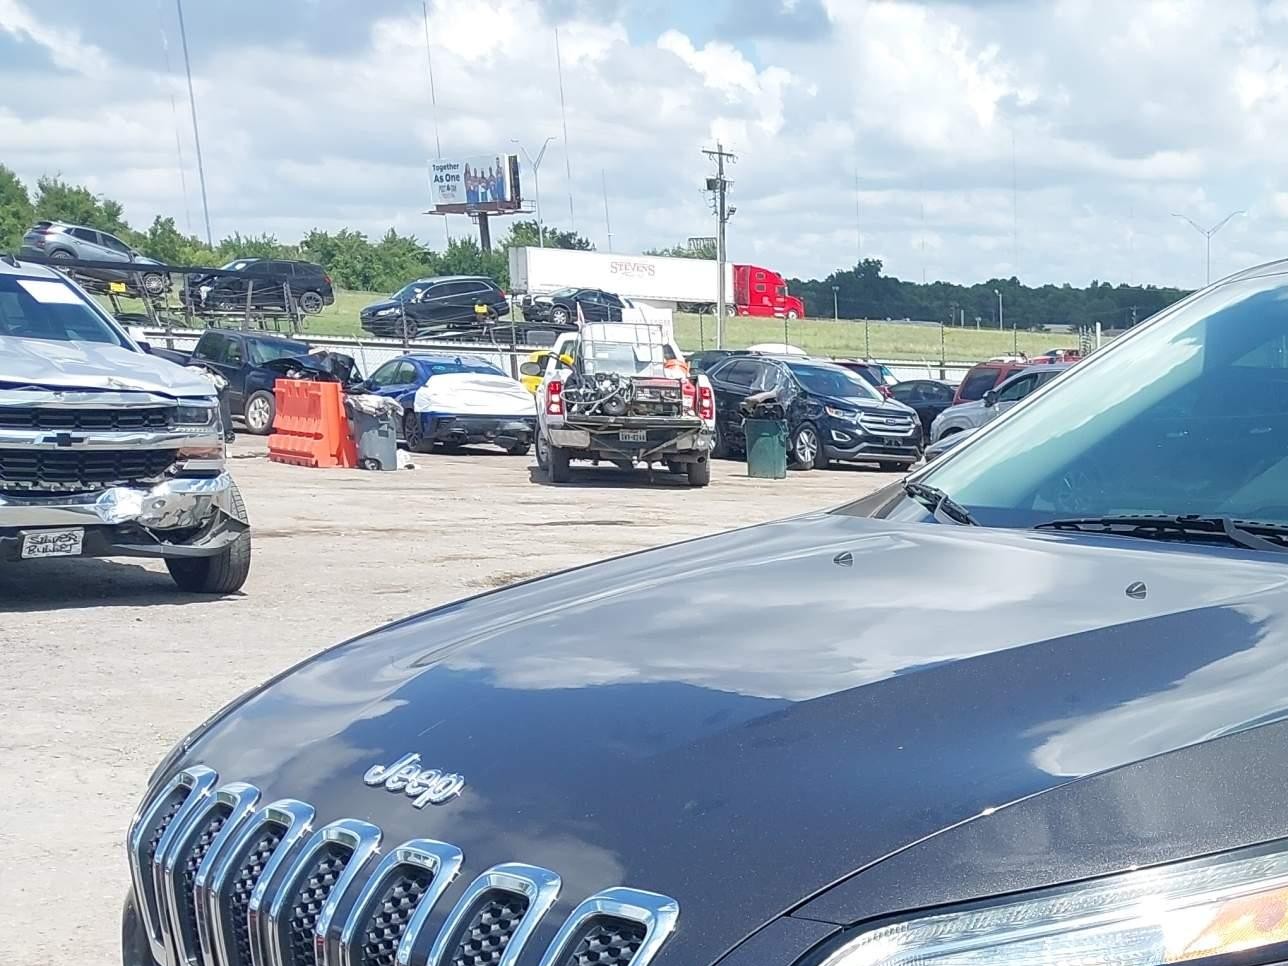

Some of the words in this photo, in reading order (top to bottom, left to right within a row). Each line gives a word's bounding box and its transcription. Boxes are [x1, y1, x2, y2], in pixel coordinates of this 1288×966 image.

[432, 163, 460, 172] Together
[433, 174, 444, 183] As
[444, 173, 461, 182] One
[363, 752, 465, 810] Jeep
